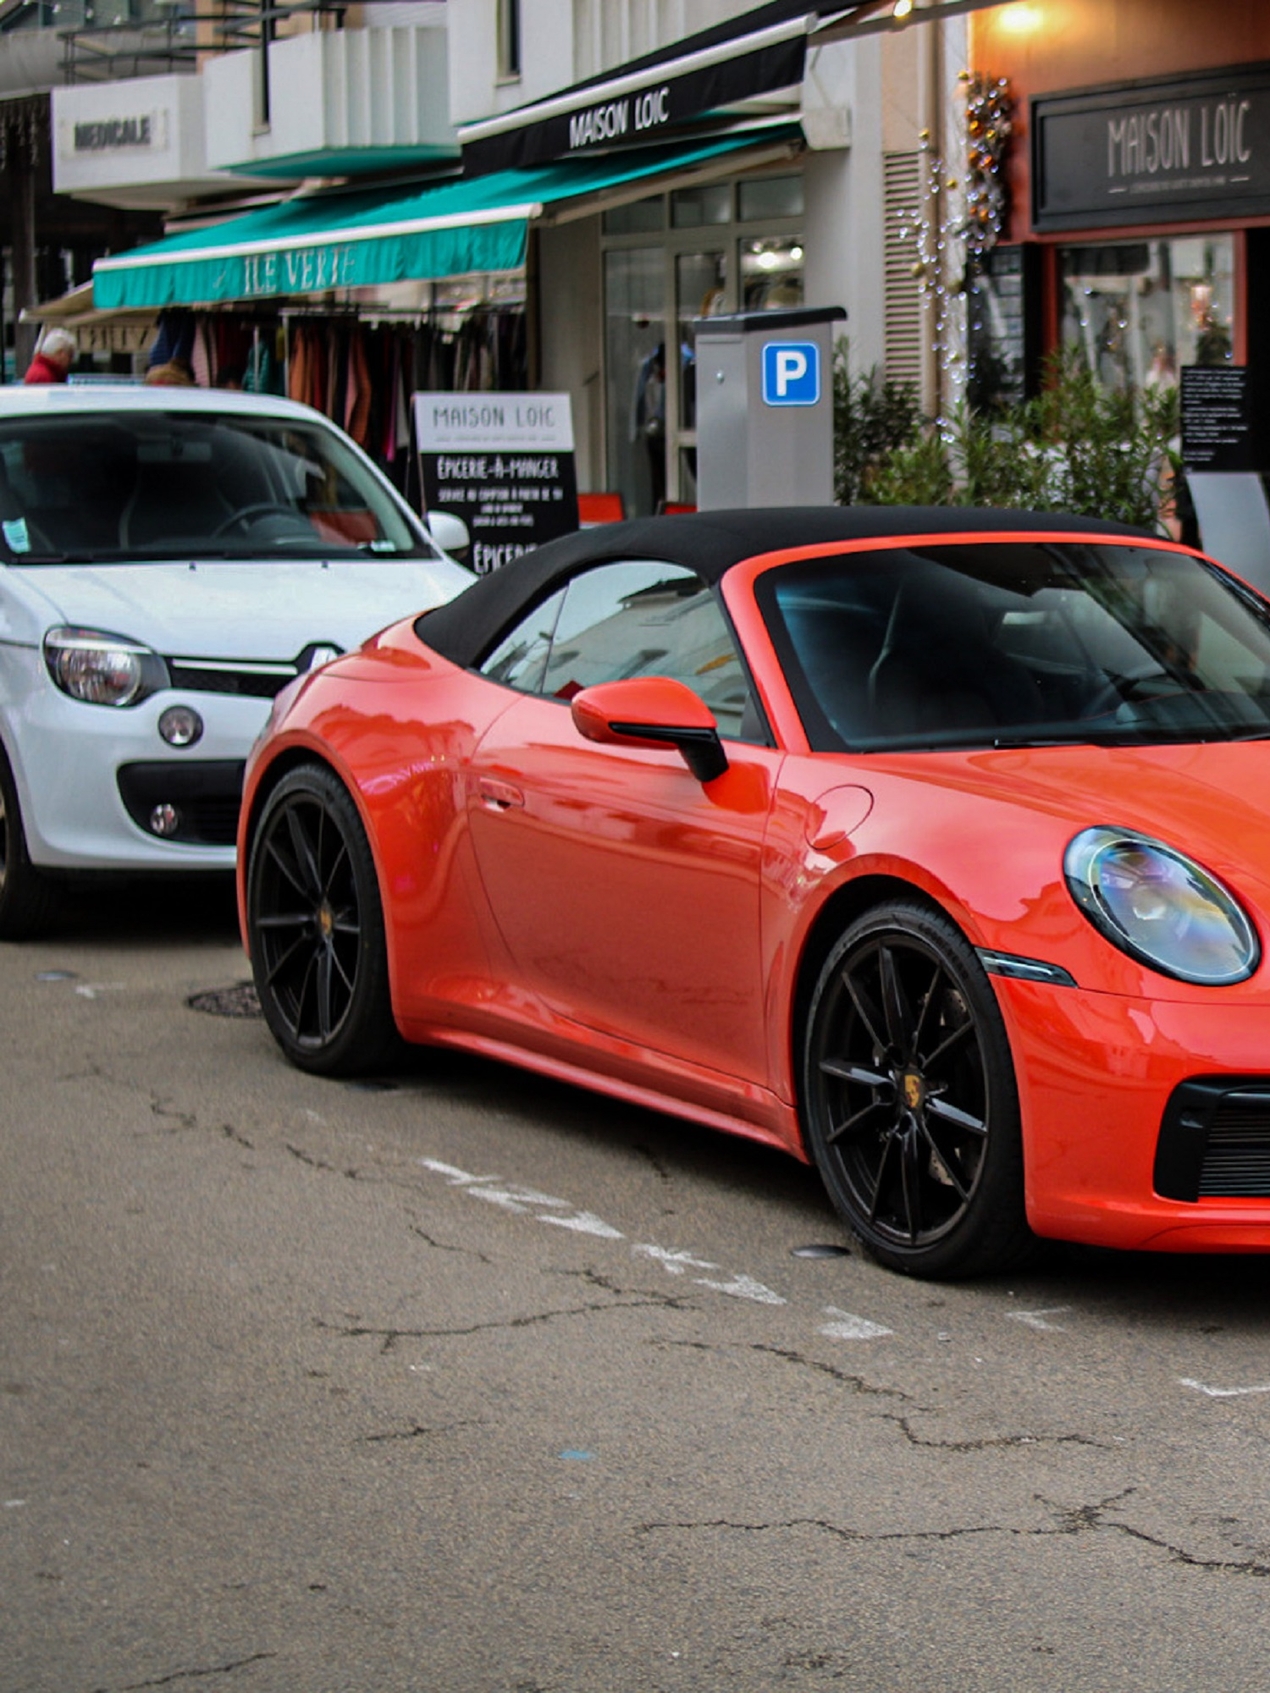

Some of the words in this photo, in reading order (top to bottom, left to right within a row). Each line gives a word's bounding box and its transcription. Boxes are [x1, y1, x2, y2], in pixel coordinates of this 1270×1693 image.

[569, 99, 629, 149] MAISON
[1107, 108, 1190, 177] MAISON
[776, 350, 807, 397] P
[432, 406, 505, 429] MAISON
